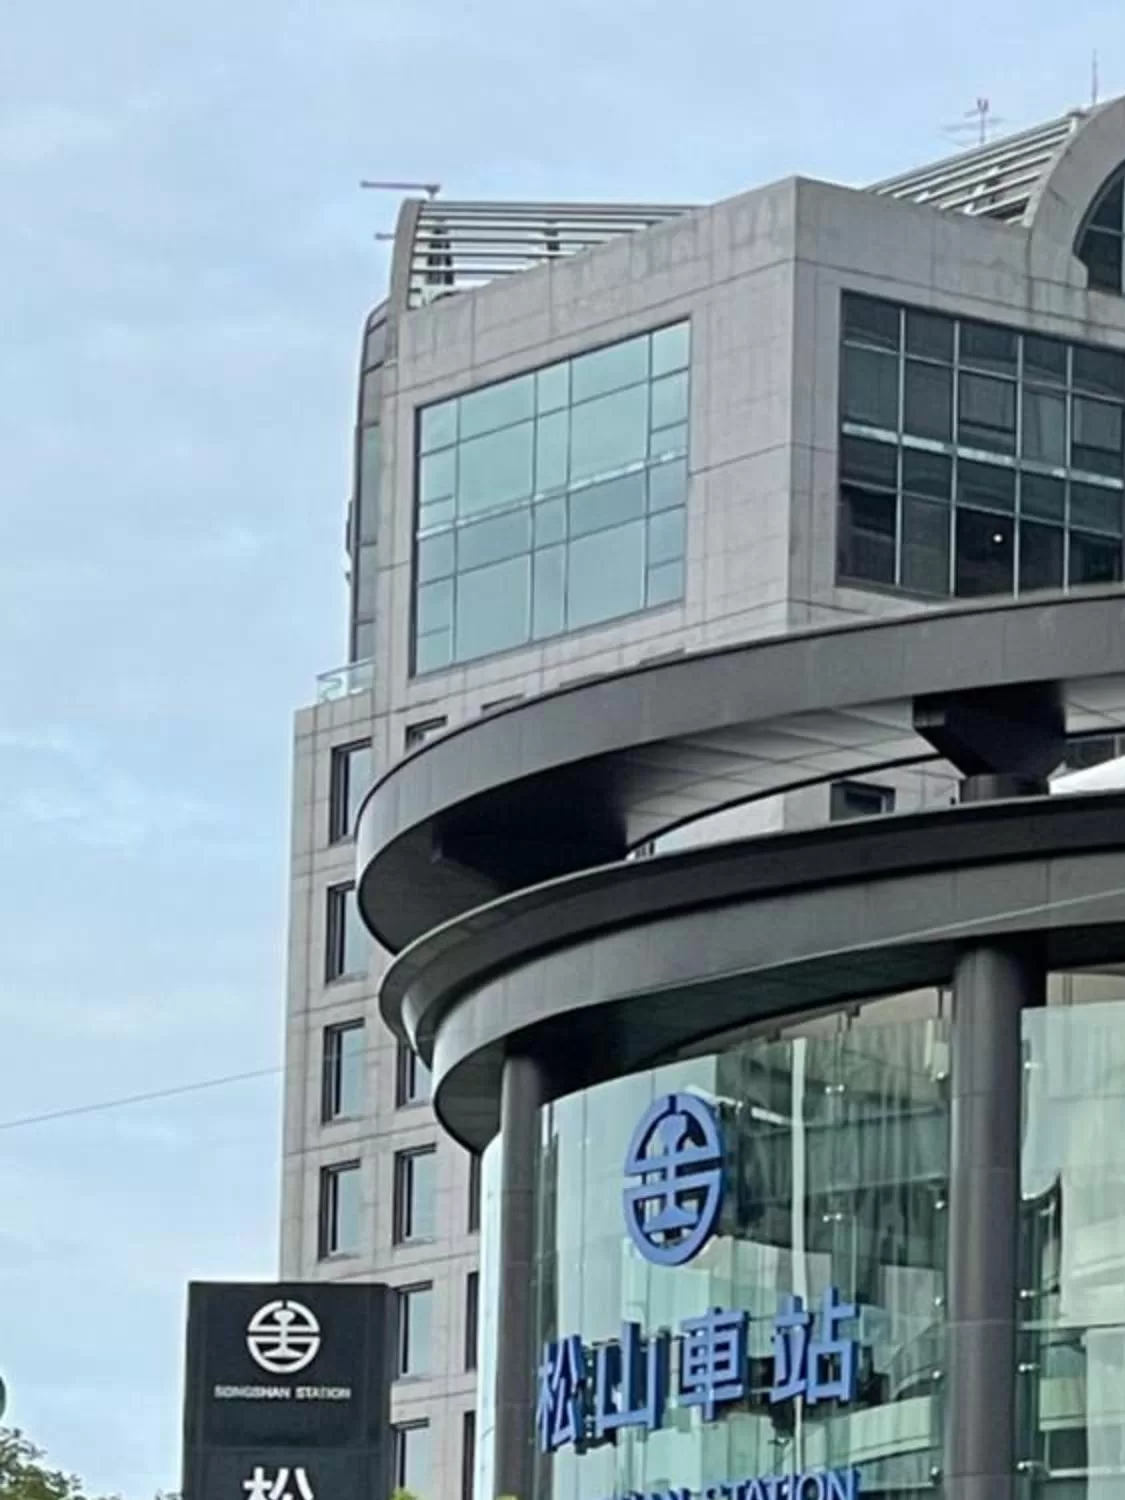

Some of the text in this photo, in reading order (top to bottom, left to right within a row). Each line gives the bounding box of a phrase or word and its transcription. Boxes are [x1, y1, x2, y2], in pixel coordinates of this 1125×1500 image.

[295, 1386, 351, 1400] STATION
[536, 1286, 861, 1455] 松山車站
